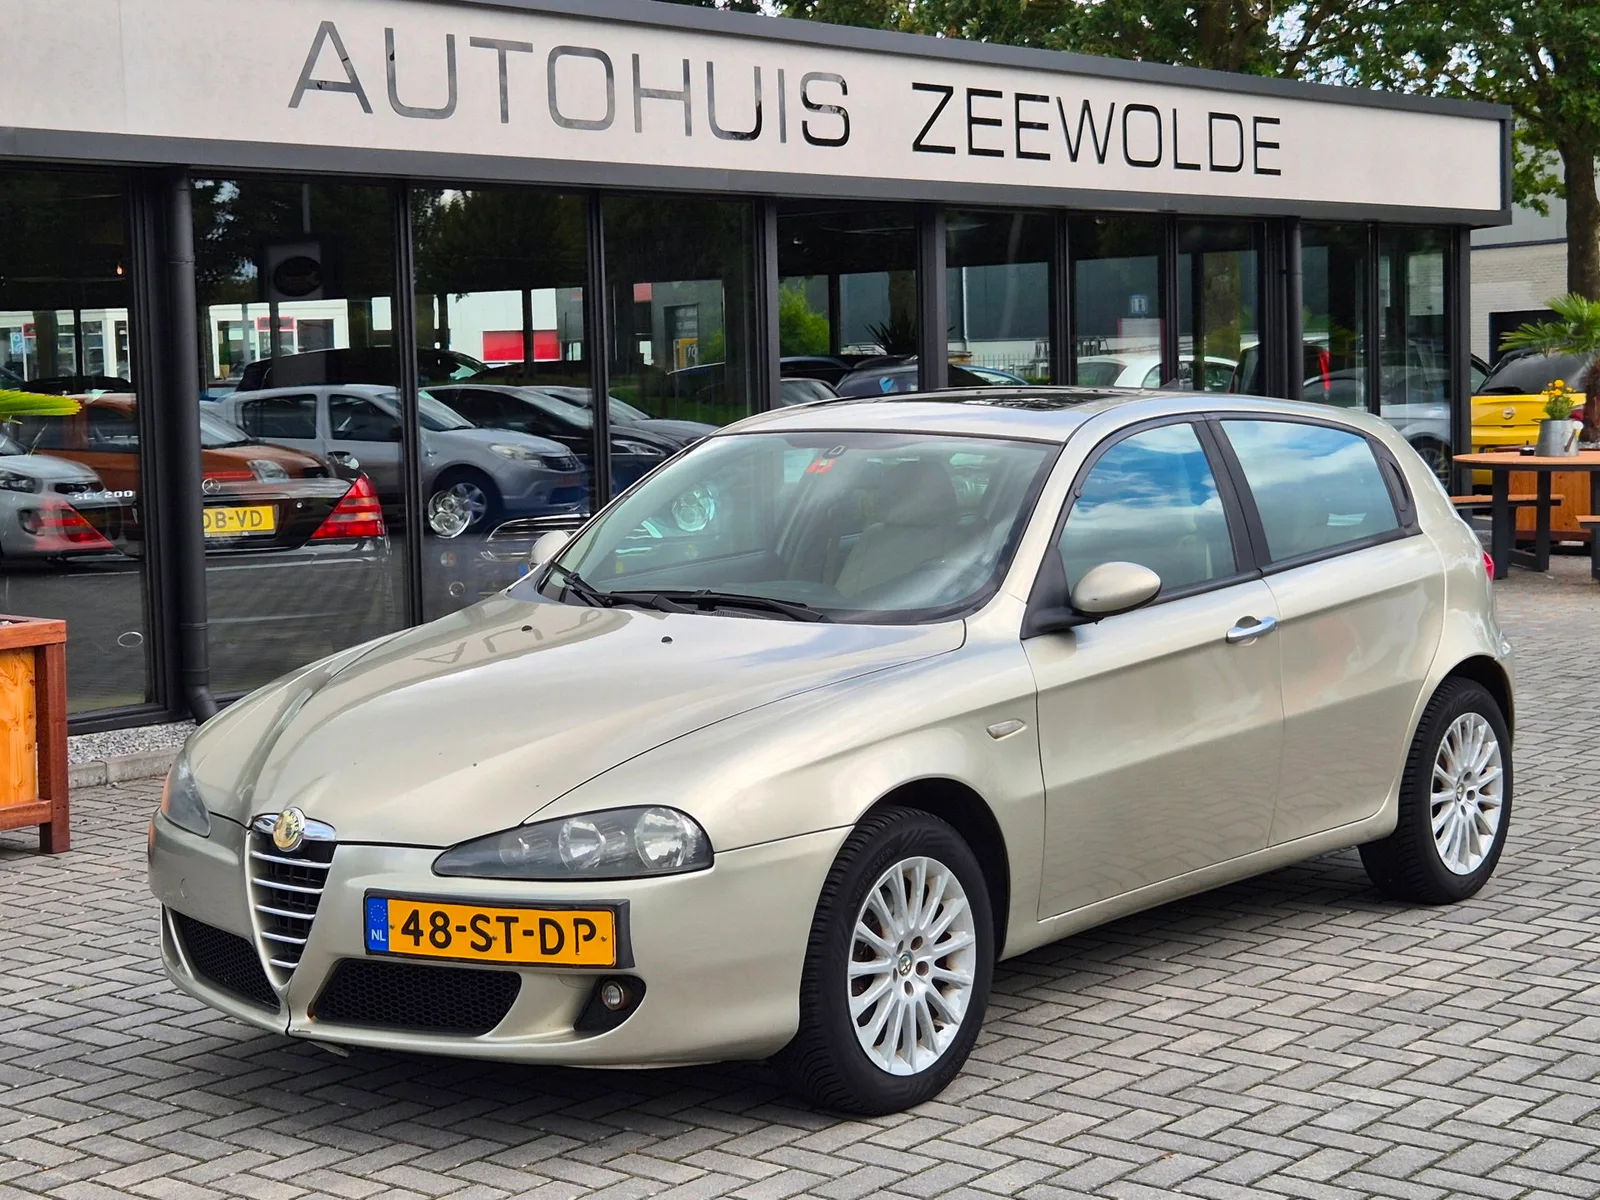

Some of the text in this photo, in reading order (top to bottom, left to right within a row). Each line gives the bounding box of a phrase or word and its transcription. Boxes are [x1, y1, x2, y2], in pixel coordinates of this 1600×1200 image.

[287, 20, 1282, 176] AUTOHUIS ZEEWOLDE
[104, 490, 133, 499] 200
[371, 929, 386, 942] NL
[400, 909, 597, 956] 48-ST-DP
